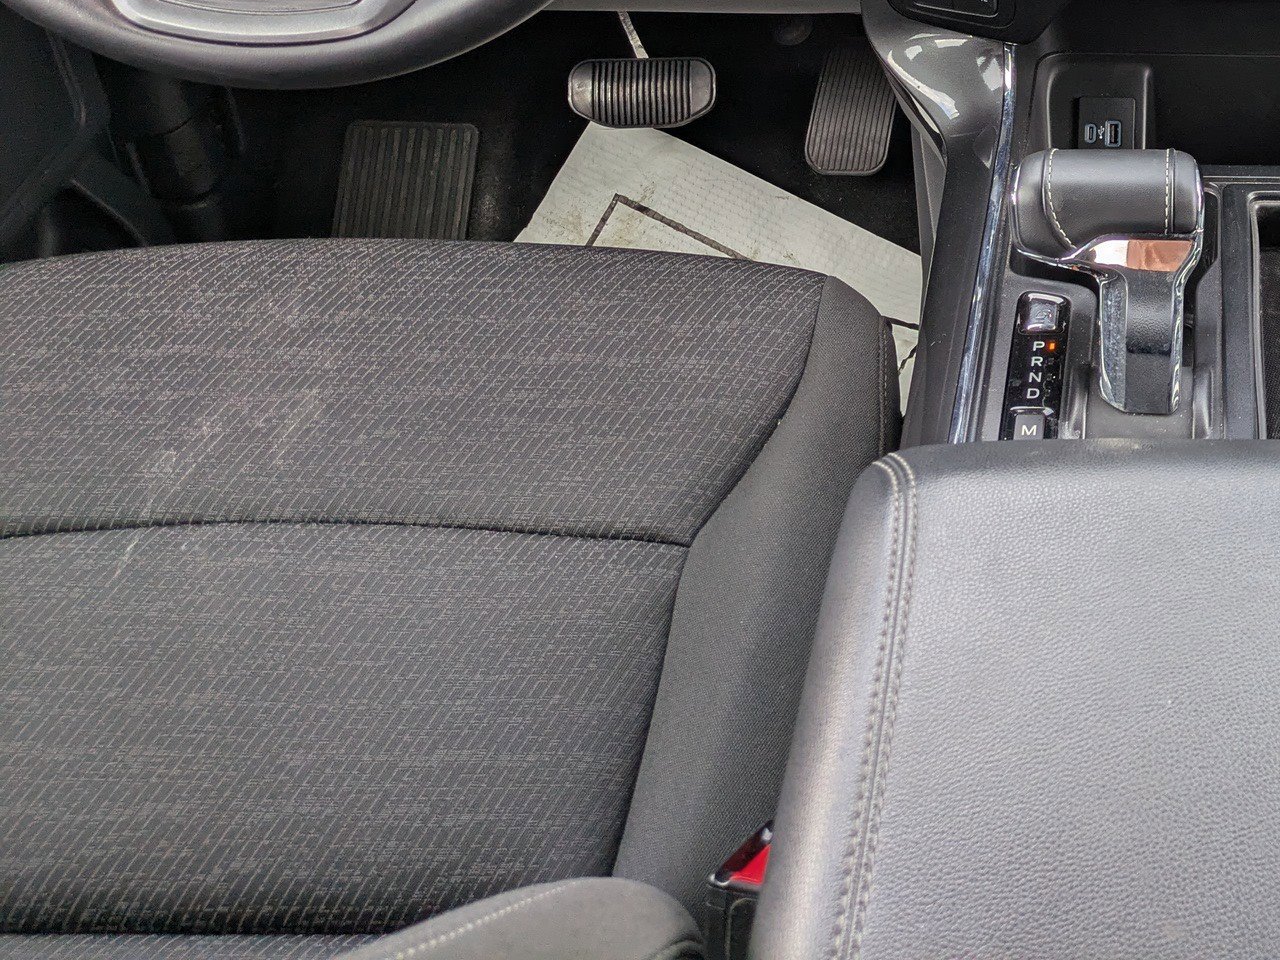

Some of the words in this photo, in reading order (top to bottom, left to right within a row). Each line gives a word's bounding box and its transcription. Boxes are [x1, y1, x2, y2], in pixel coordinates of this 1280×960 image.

[1032, 341, 1045, 351] P
[1030, 356, 1043, 366] R
[1028, 372, 1042, 382] N
[1026, 388, 1040, 398] D
[1021, 424, 1037, 436] M
